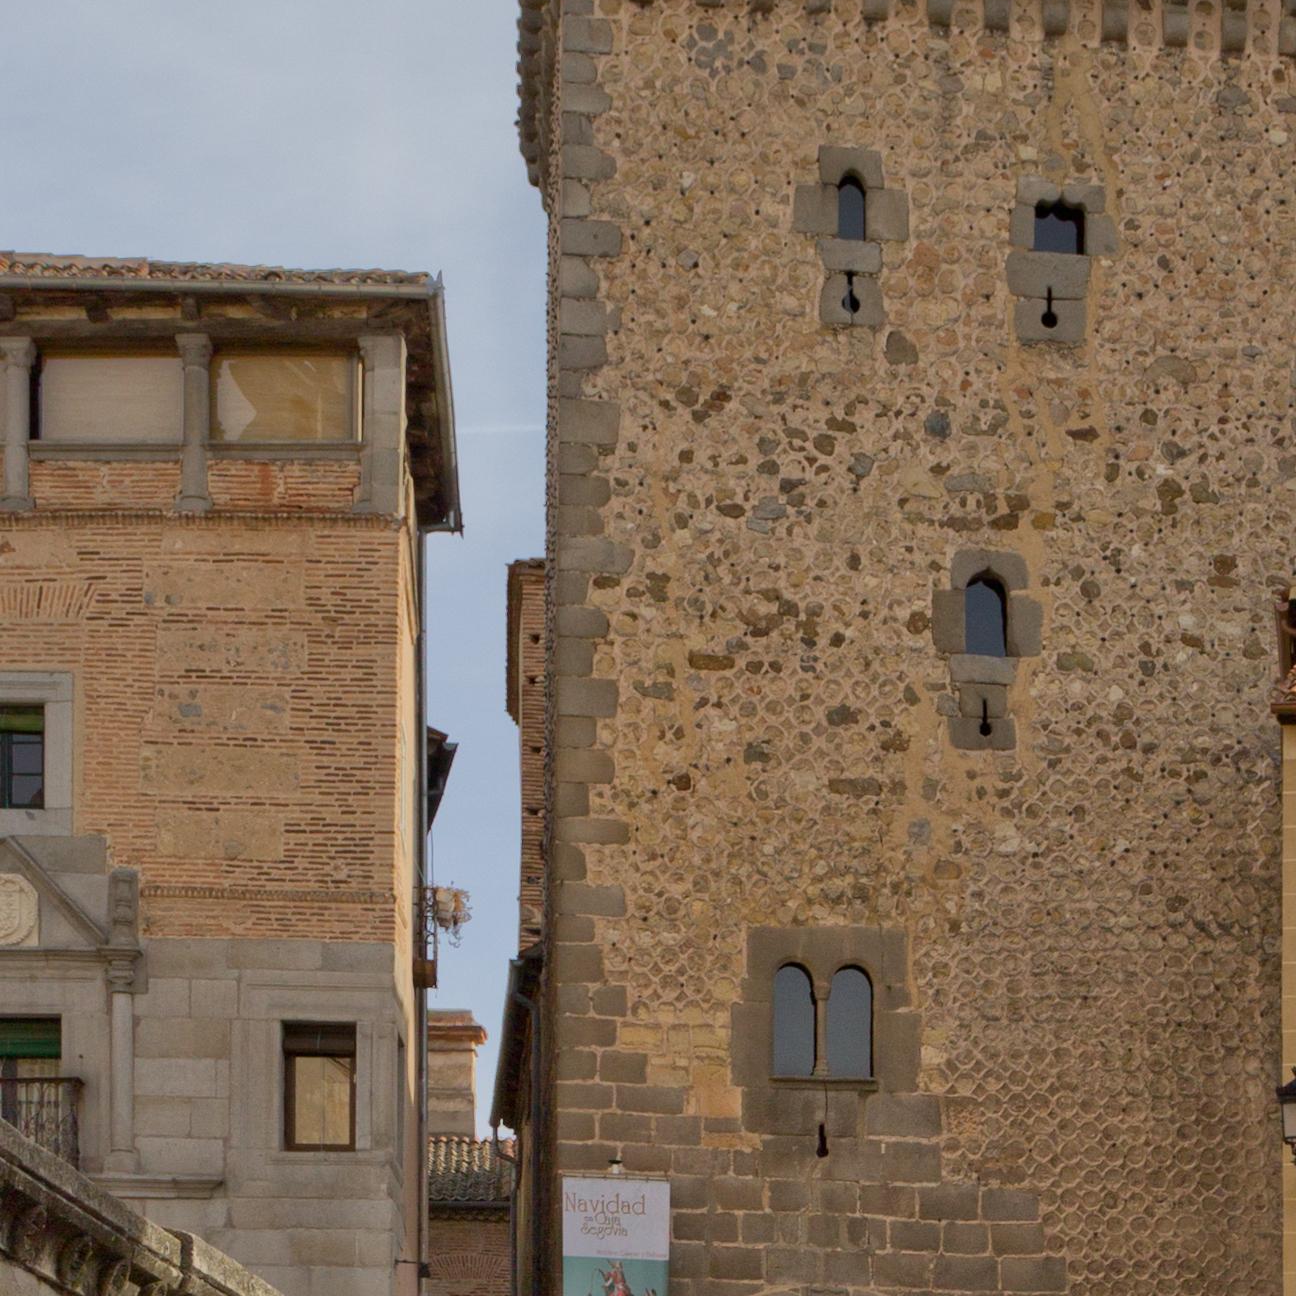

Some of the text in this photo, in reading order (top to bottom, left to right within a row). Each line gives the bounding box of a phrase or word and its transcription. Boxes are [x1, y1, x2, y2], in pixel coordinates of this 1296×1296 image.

[565, 1192, 646, 1215] Navidad
[595, 1211, 621, 1227] Caja
[581, 1222, 628, 1240] Segovia
